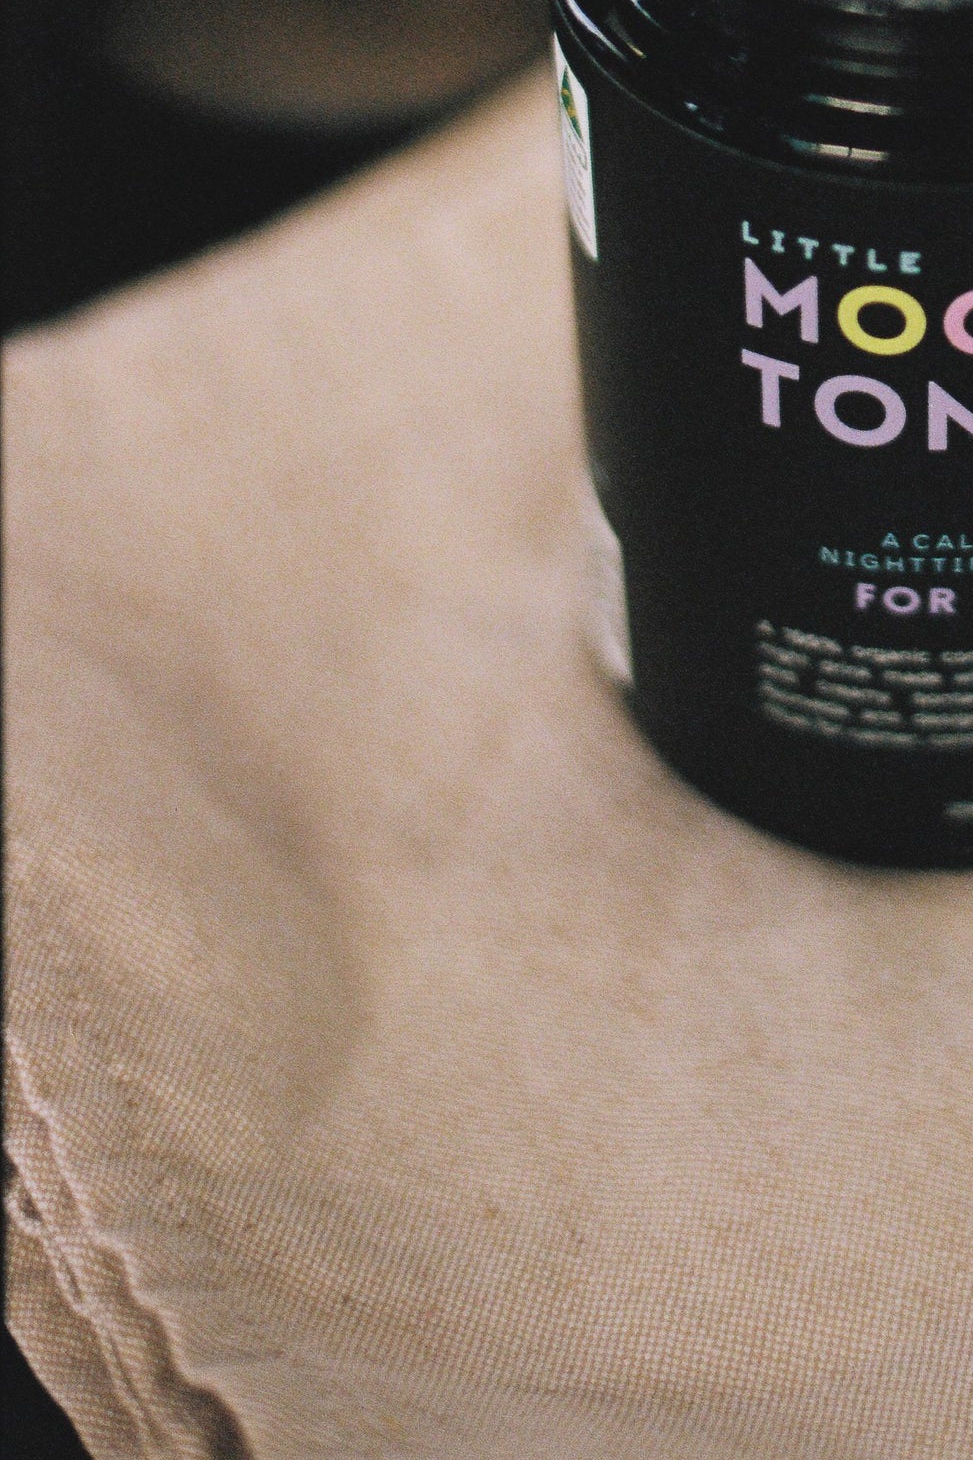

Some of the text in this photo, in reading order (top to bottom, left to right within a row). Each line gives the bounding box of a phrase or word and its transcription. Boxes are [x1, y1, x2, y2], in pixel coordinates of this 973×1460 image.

[741, 220, 922, 275] LITTLE
[881, 532, 900, 549] A
[854, 581, 958, 616] FOR
